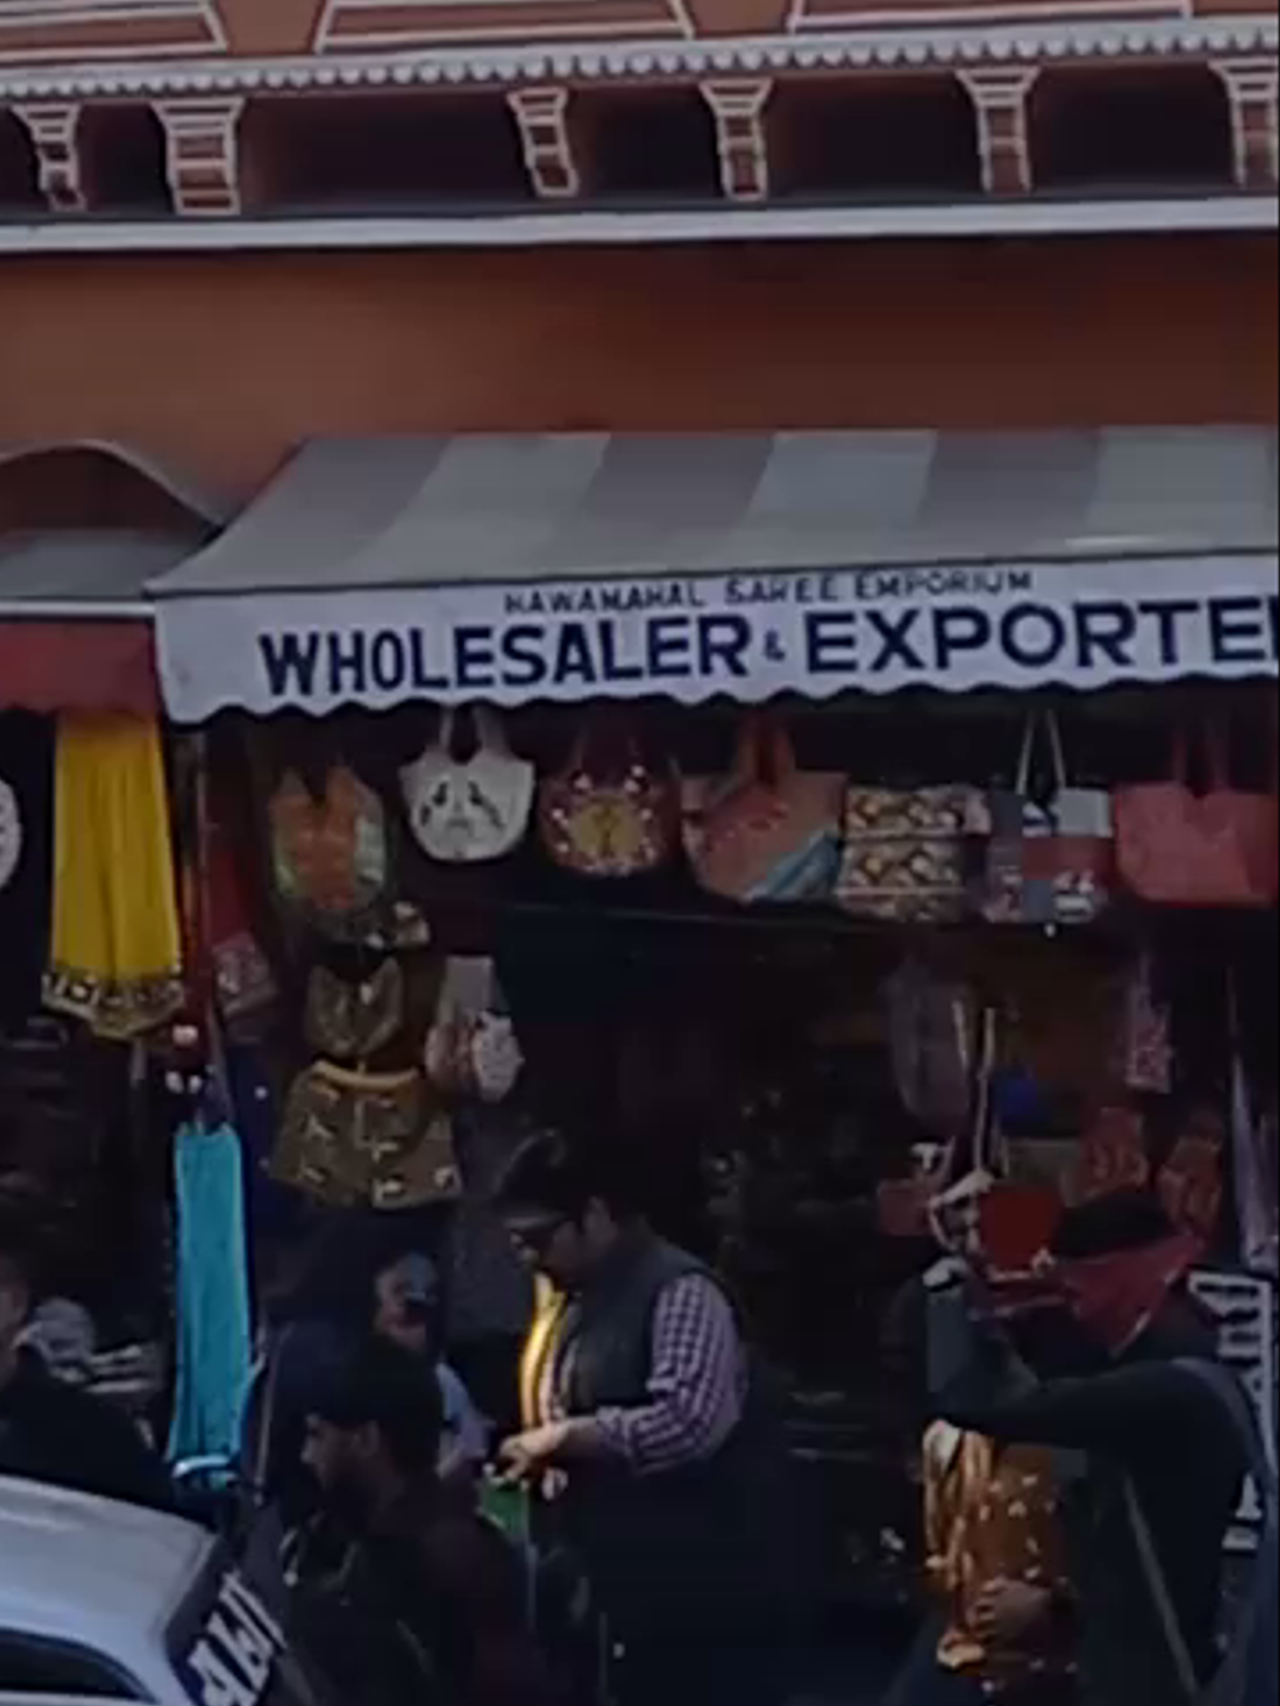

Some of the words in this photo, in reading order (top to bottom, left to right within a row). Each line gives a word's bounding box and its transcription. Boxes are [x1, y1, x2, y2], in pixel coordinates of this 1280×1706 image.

[504, 582, 705, 615] HAWAMAHAL
[725, 571, 839, 604] SAREE
[856, 569, 1033, 600] EMPORIUM
[256, 614, 754, 698] WHOLESALER
[762, 630, 787, 662] &
[805, 594, 1278, 677] EXPORTE
